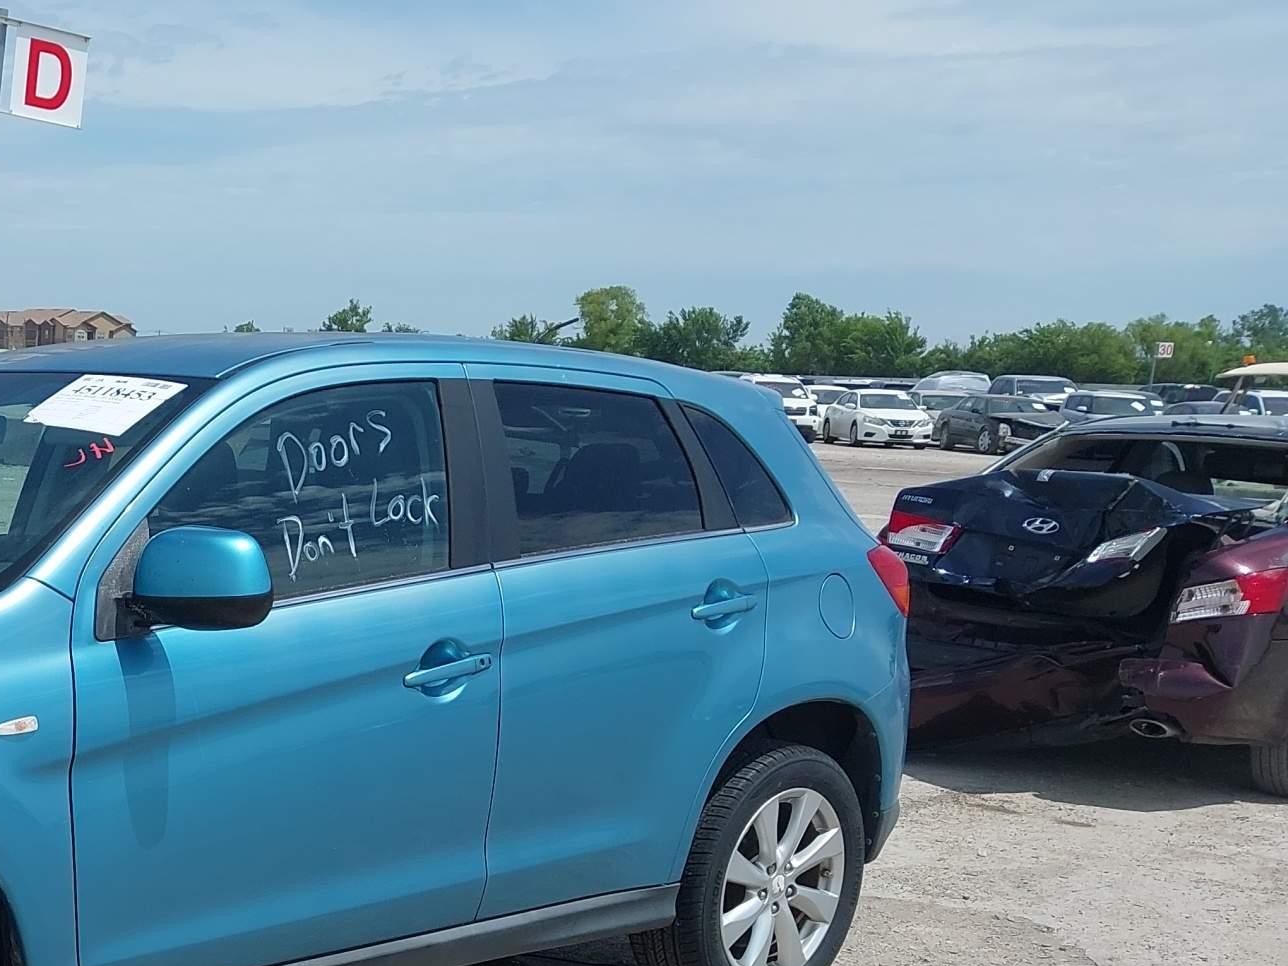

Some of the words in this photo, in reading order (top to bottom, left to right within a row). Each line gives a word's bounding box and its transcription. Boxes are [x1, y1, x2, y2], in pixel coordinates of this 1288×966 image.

[24, 37, 73, 111] D
[1159, 344, 1173, 356] 30
[72, 385, 157, 401] 45118453
[276, 409, 392, 504] Doors
[276, 492, 358, 583] Don't
